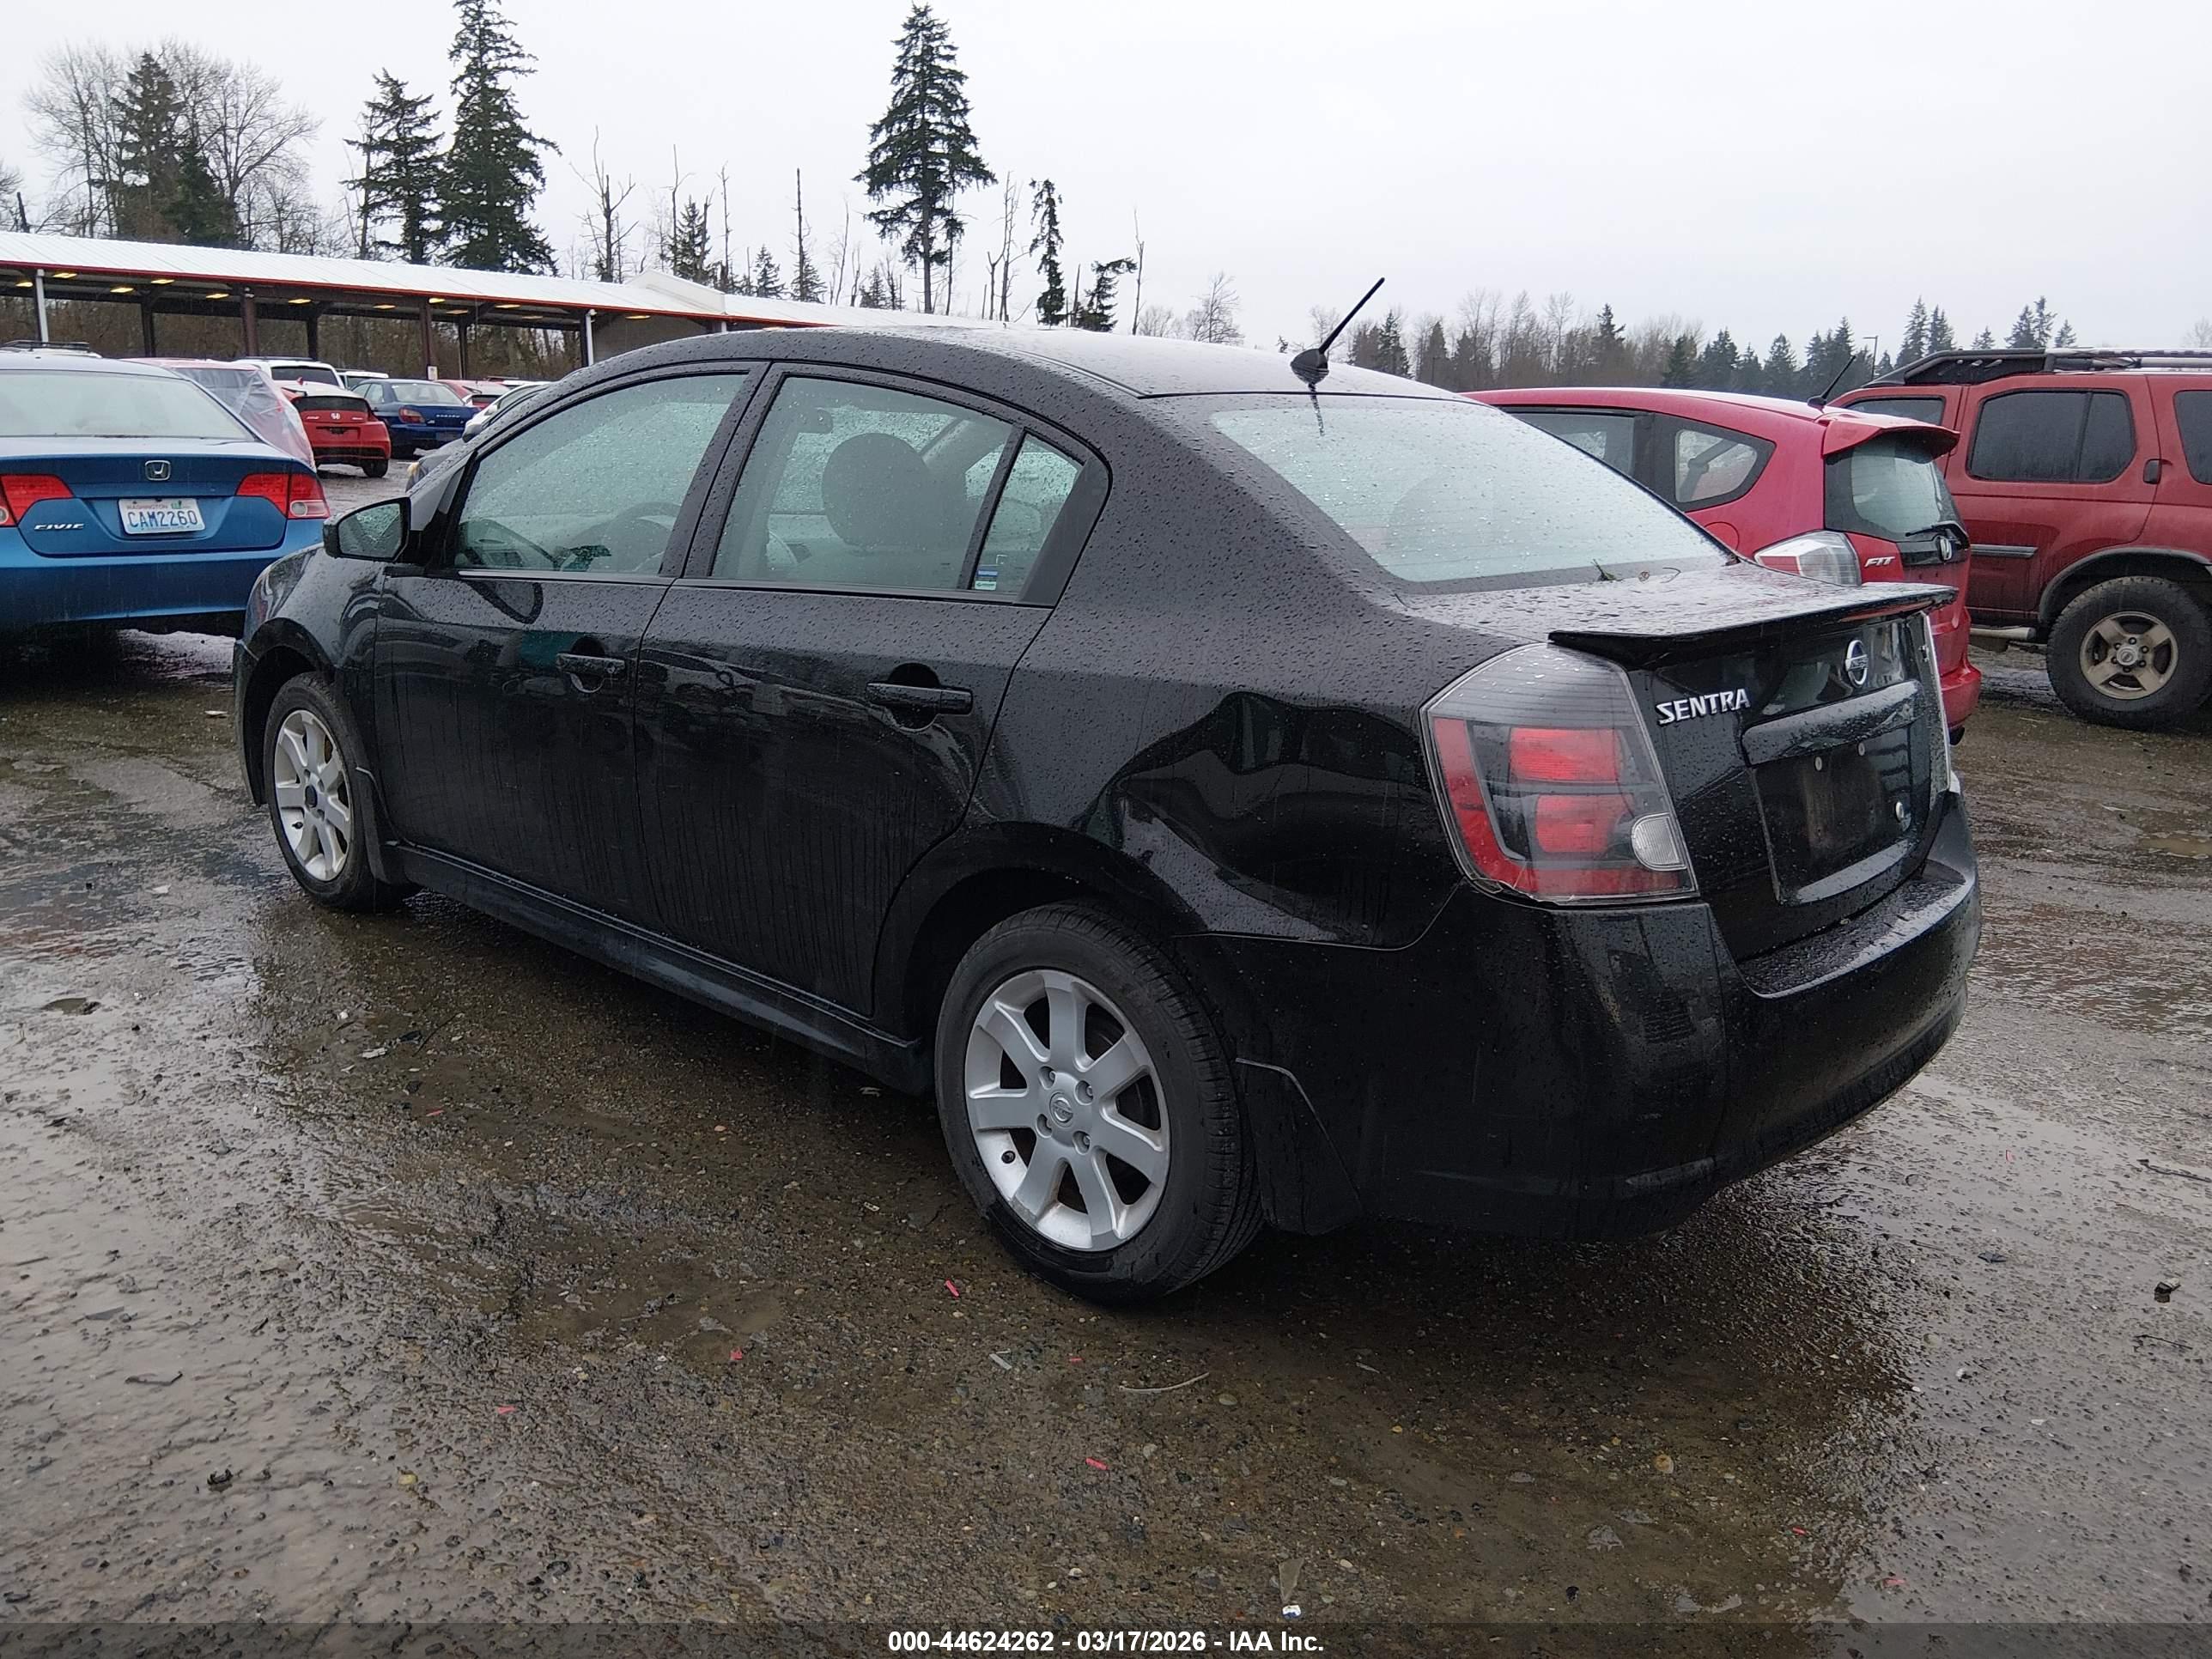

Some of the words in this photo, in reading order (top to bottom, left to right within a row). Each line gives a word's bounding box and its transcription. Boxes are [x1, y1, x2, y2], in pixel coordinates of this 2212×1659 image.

[127, 510, 198, 528] CAM2260
[1864, 556, 1896, 568] FIT
[1656, 689, 1751, 725] SENTRA
